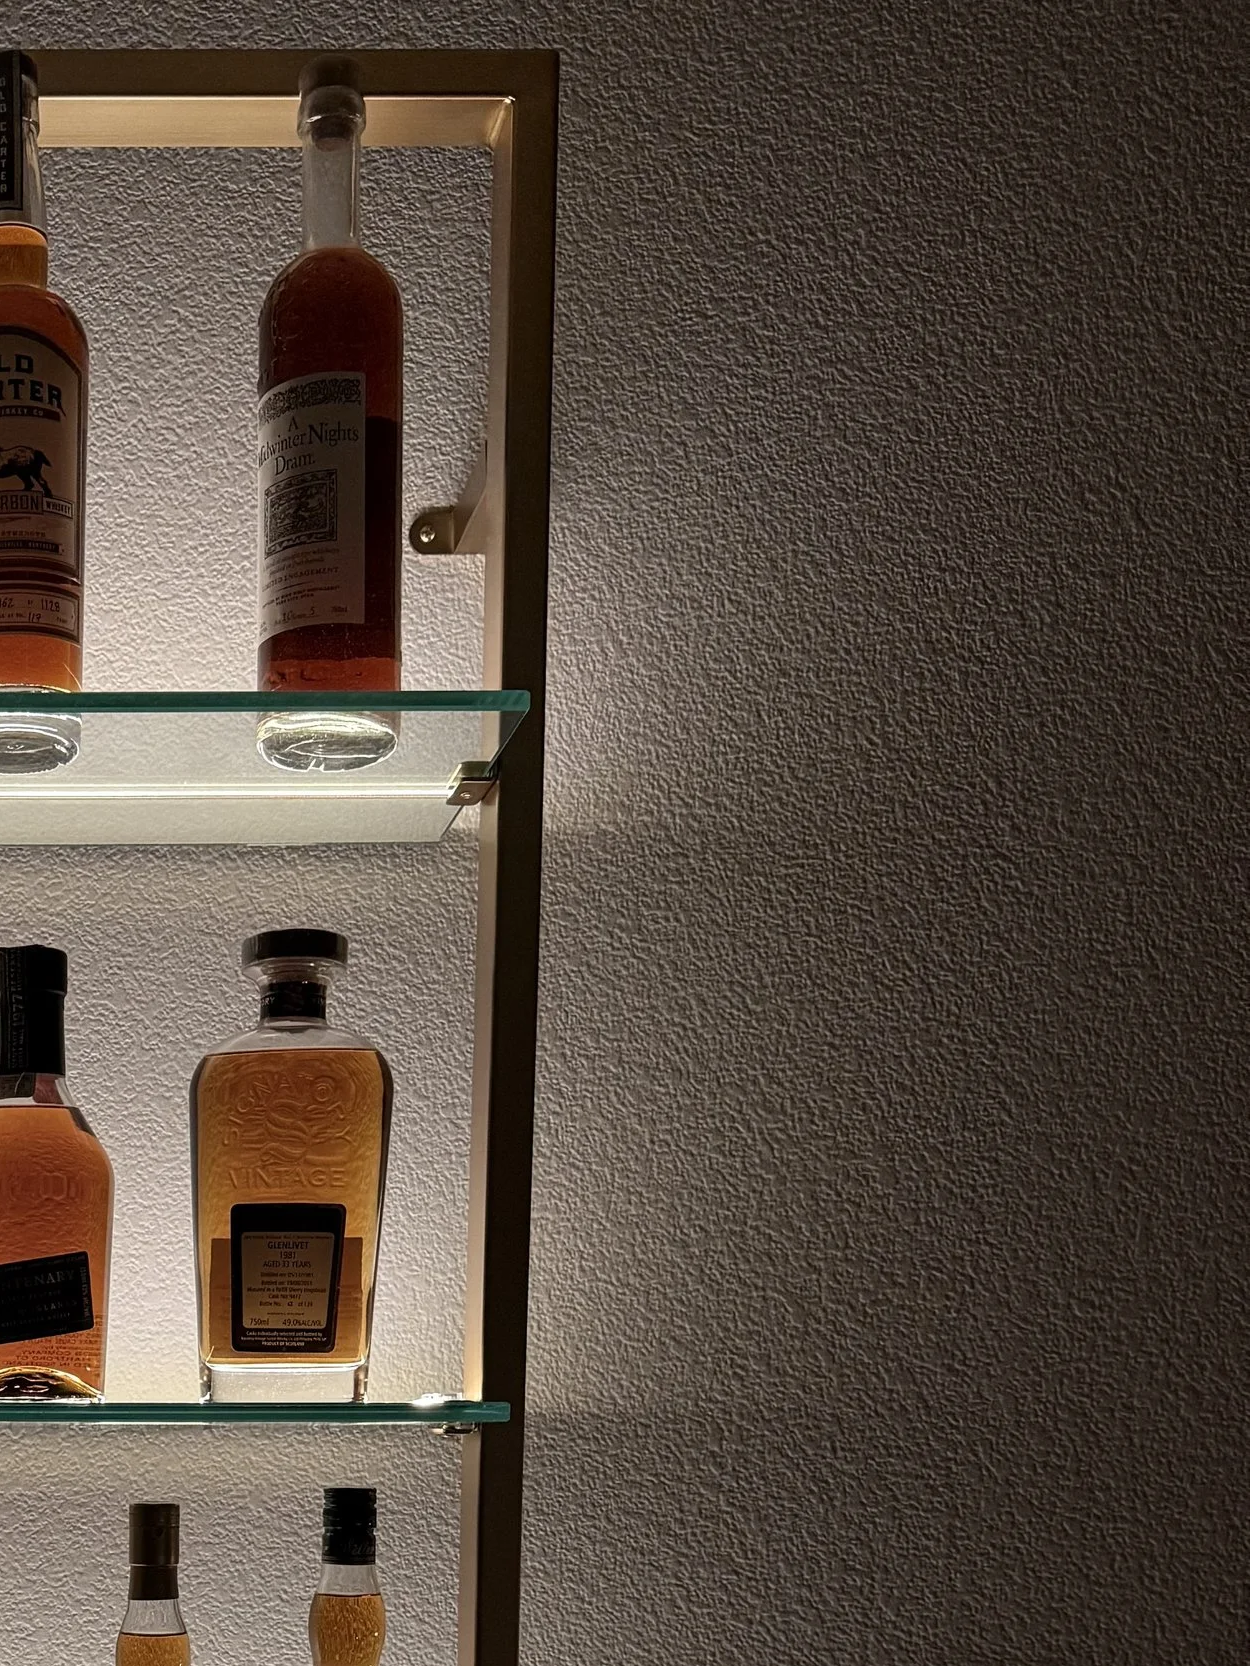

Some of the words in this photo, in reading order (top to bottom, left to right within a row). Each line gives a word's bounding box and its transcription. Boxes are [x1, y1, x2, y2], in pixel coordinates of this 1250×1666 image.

[288, 416, 300, 433] A
[276, 454, 316, 476] Dram.
[46, 500, 71, 515] WHISKEY
[230, 1167, 347, 1189] VINTAGE
[268, 1242, 310, 1250] GLENLIVET
[280, 1252, 296, 1260] 1981
[263, 1260, 281, 1268] AGED
[292, 1260, 312, 1269] YEARS
[250, 1318, 270, 1326] 750ml
